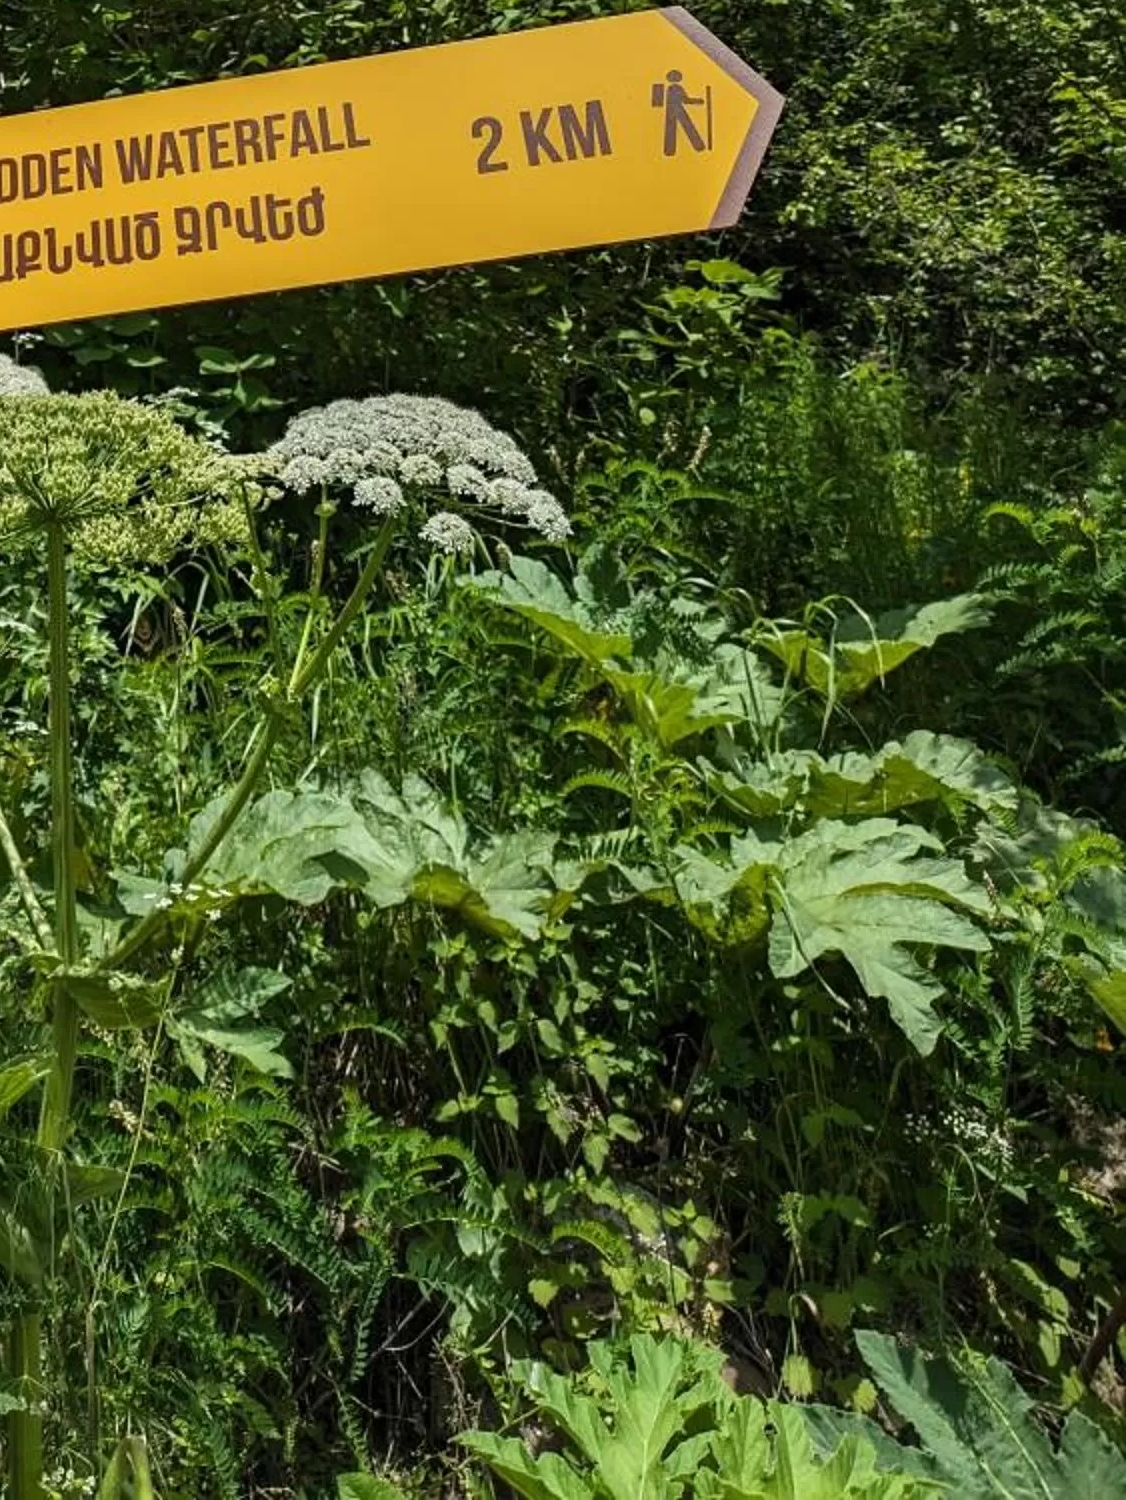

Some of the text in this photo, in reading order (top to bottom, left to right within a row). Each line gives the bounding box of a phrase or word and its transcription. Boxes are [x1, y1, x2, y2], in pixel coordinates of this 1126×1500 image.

[115, 102, 371, 184] WATERFALL
[471, 99, 613, 174] 2 KM
